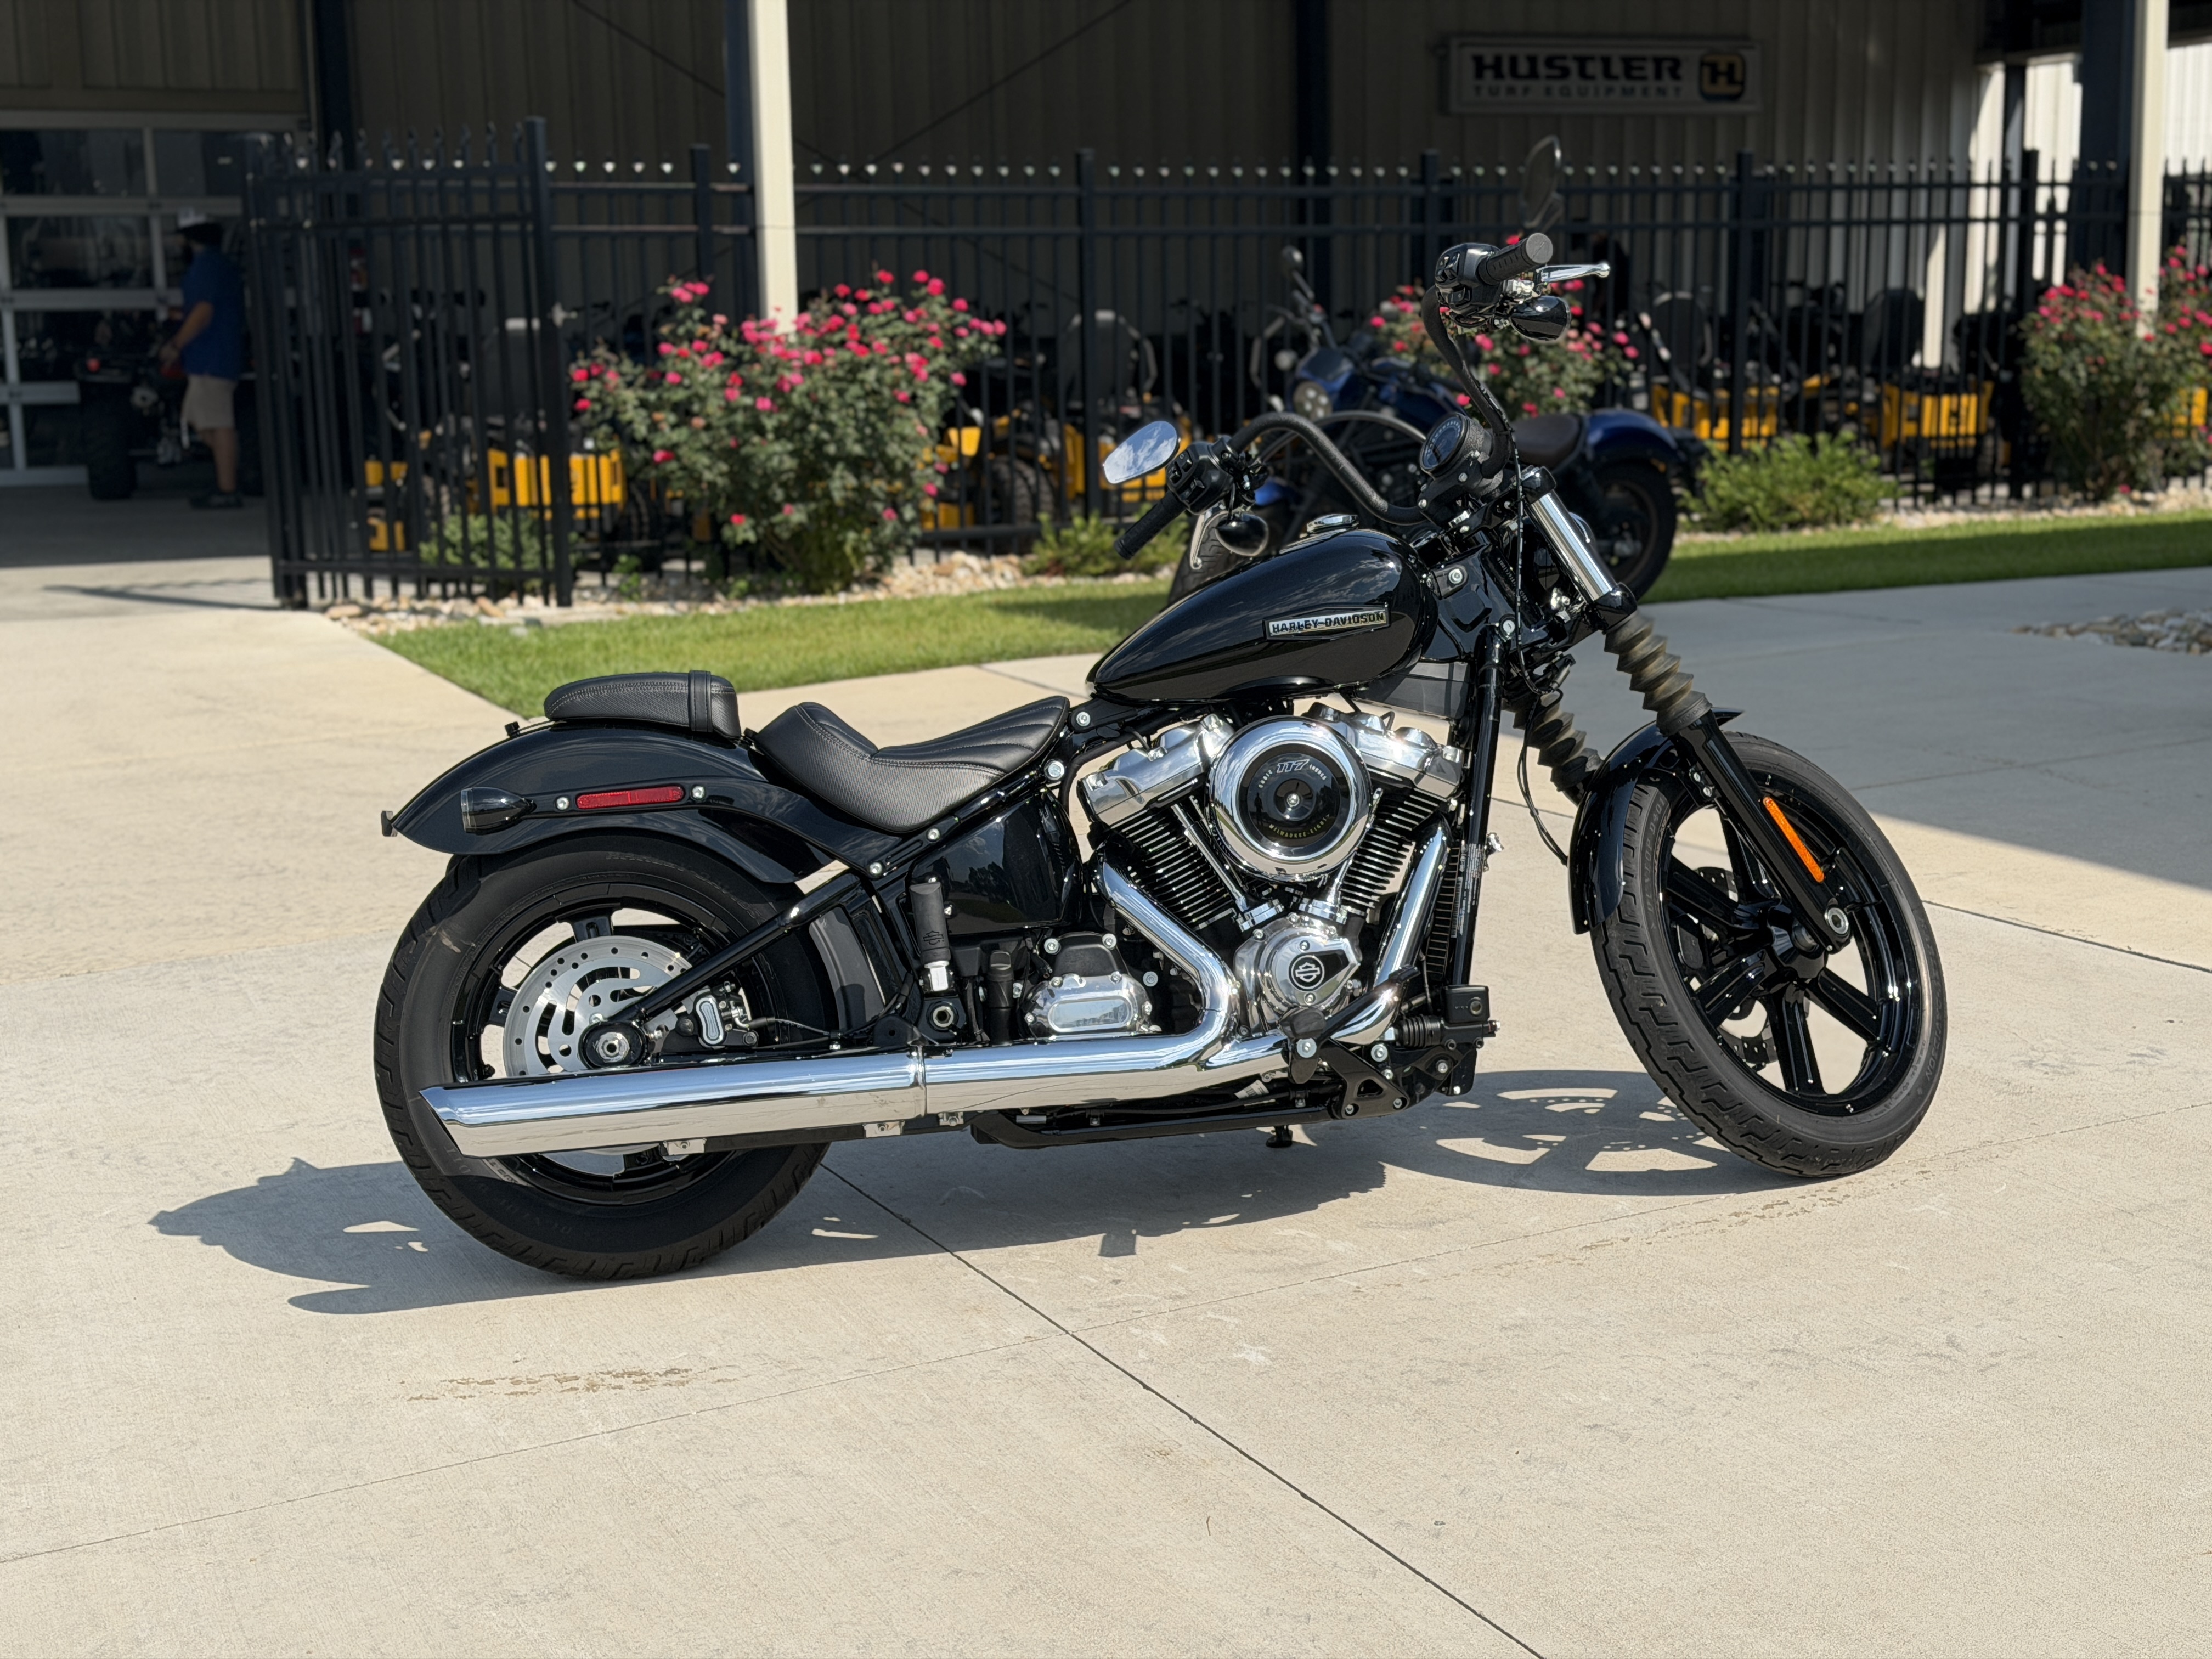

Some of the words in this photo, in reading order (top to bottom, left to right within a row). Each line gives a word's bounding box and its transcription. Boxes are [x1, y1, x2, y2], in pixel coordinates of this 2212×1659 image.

[1471, 54, 1683, 81] HUSTLER
[1474, 84, 1532, 98] TURF
[1544, 85, 1683, 98] EQUIPMENT
[1272, 612, 1384, 633] HARLEY-DAVIDSON
[1258, 769, 1273, 788] CUBIC
[1276, 759, 1310, 774] 117
[1309, 764, 1327, 780] INCHES
